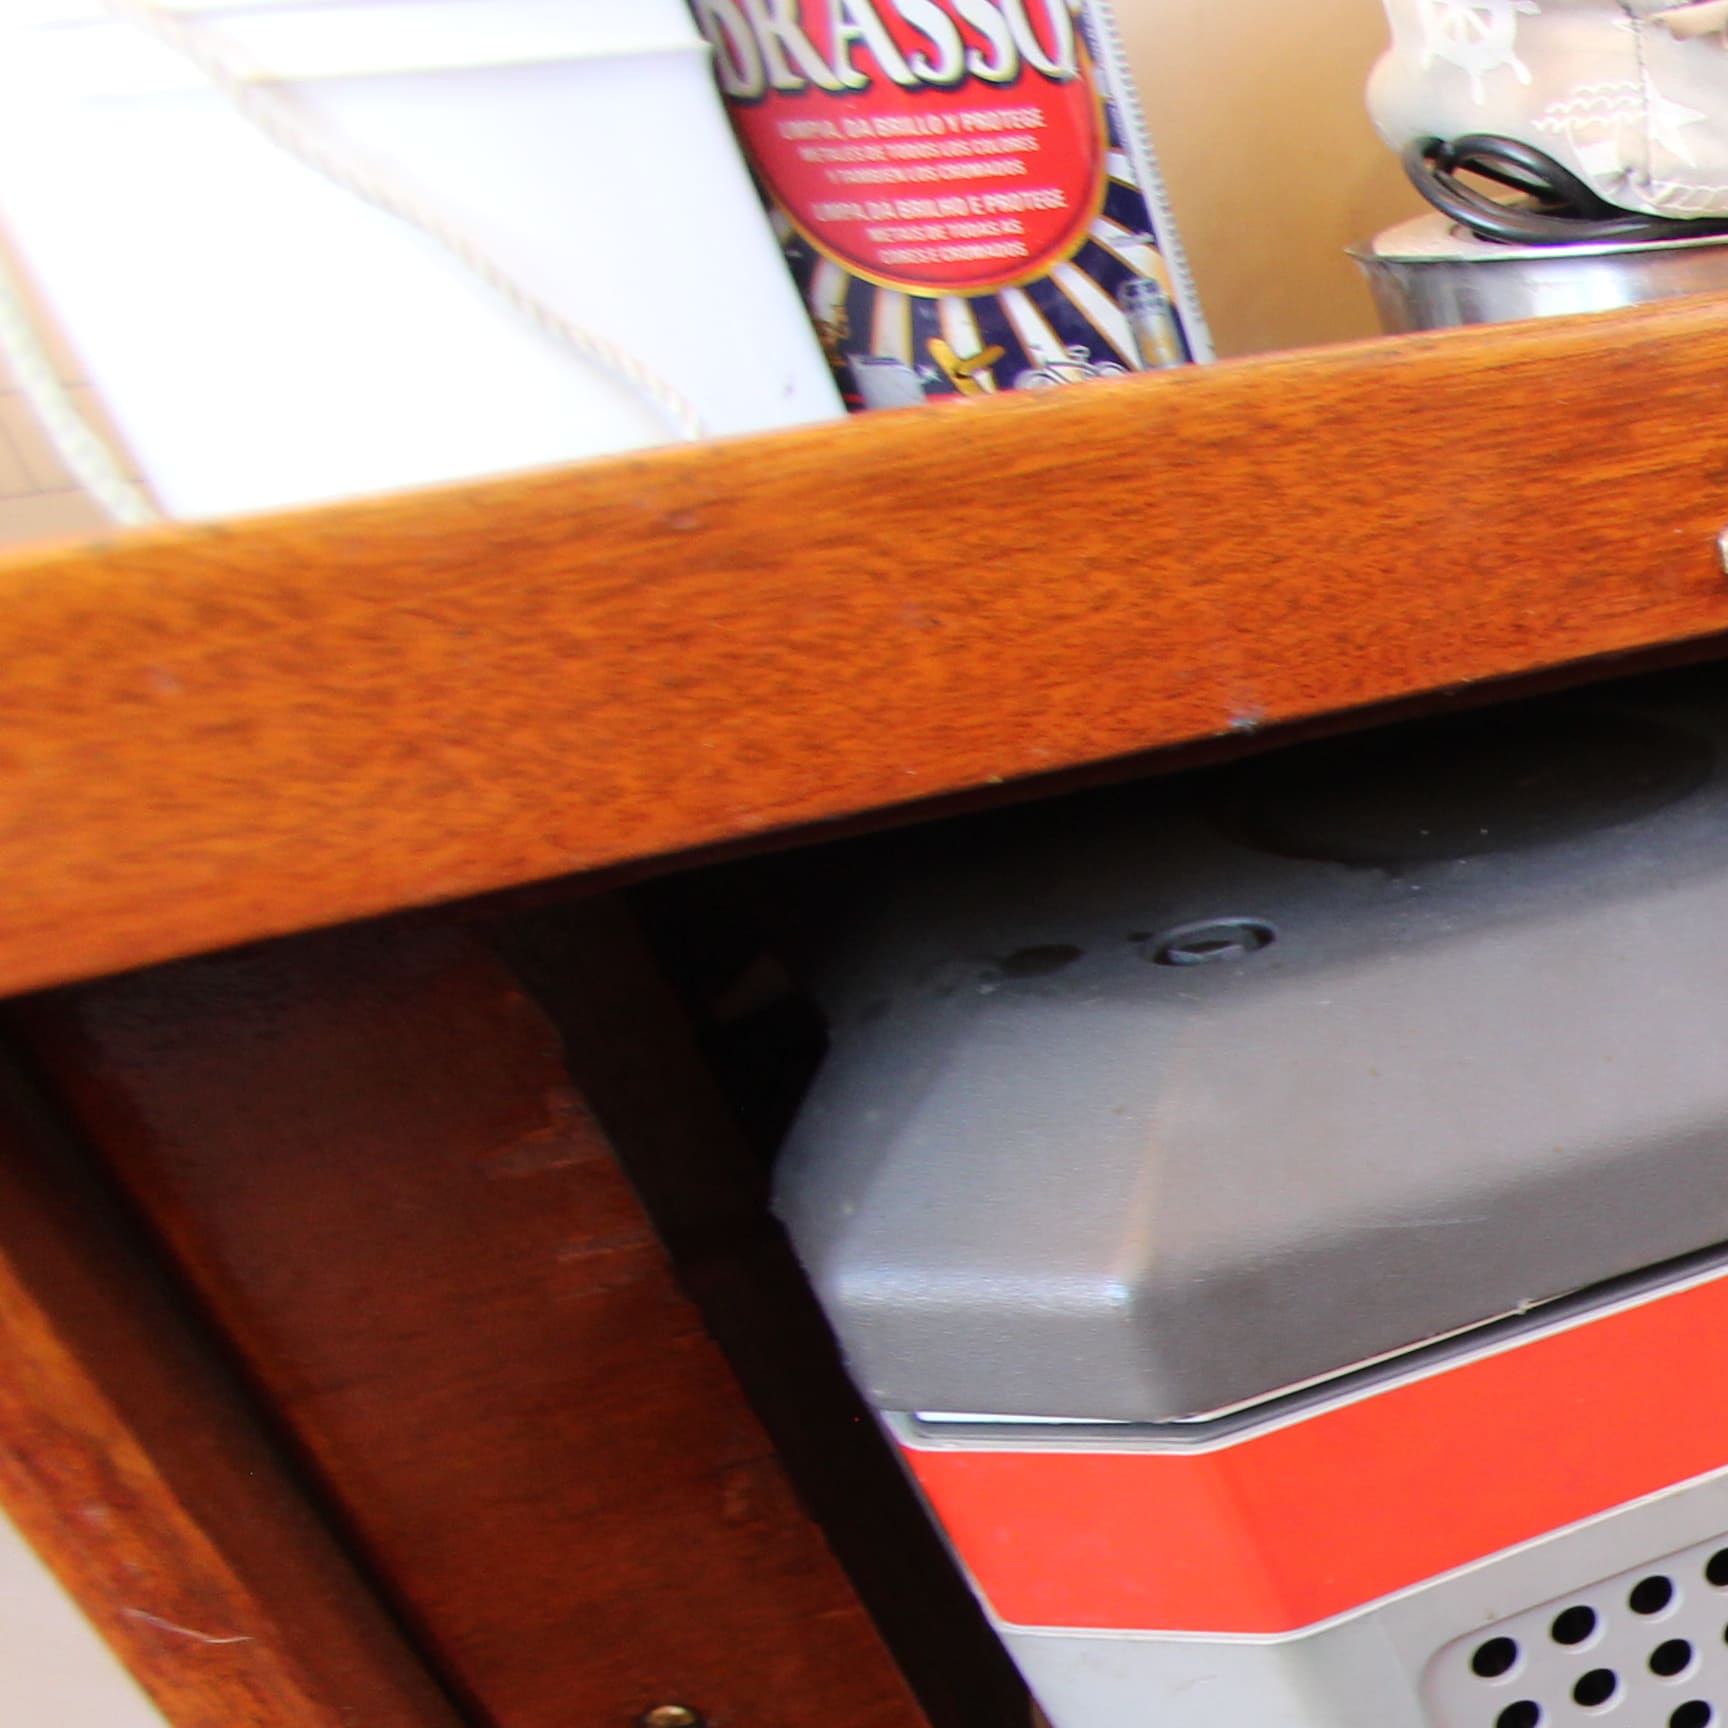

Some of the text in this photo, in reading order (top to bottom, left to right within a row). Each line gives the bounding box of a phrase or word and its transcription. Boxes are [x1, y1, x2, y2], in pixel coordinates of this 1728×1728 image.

[869, 111, 946, 138] BRILLO
[939, 110, 961, 134] Y
[958, 106, 1048, 133] PROTEGE
[964, 193, 988, 216] E
[981, 187, 1069, 214] PROTEGE
